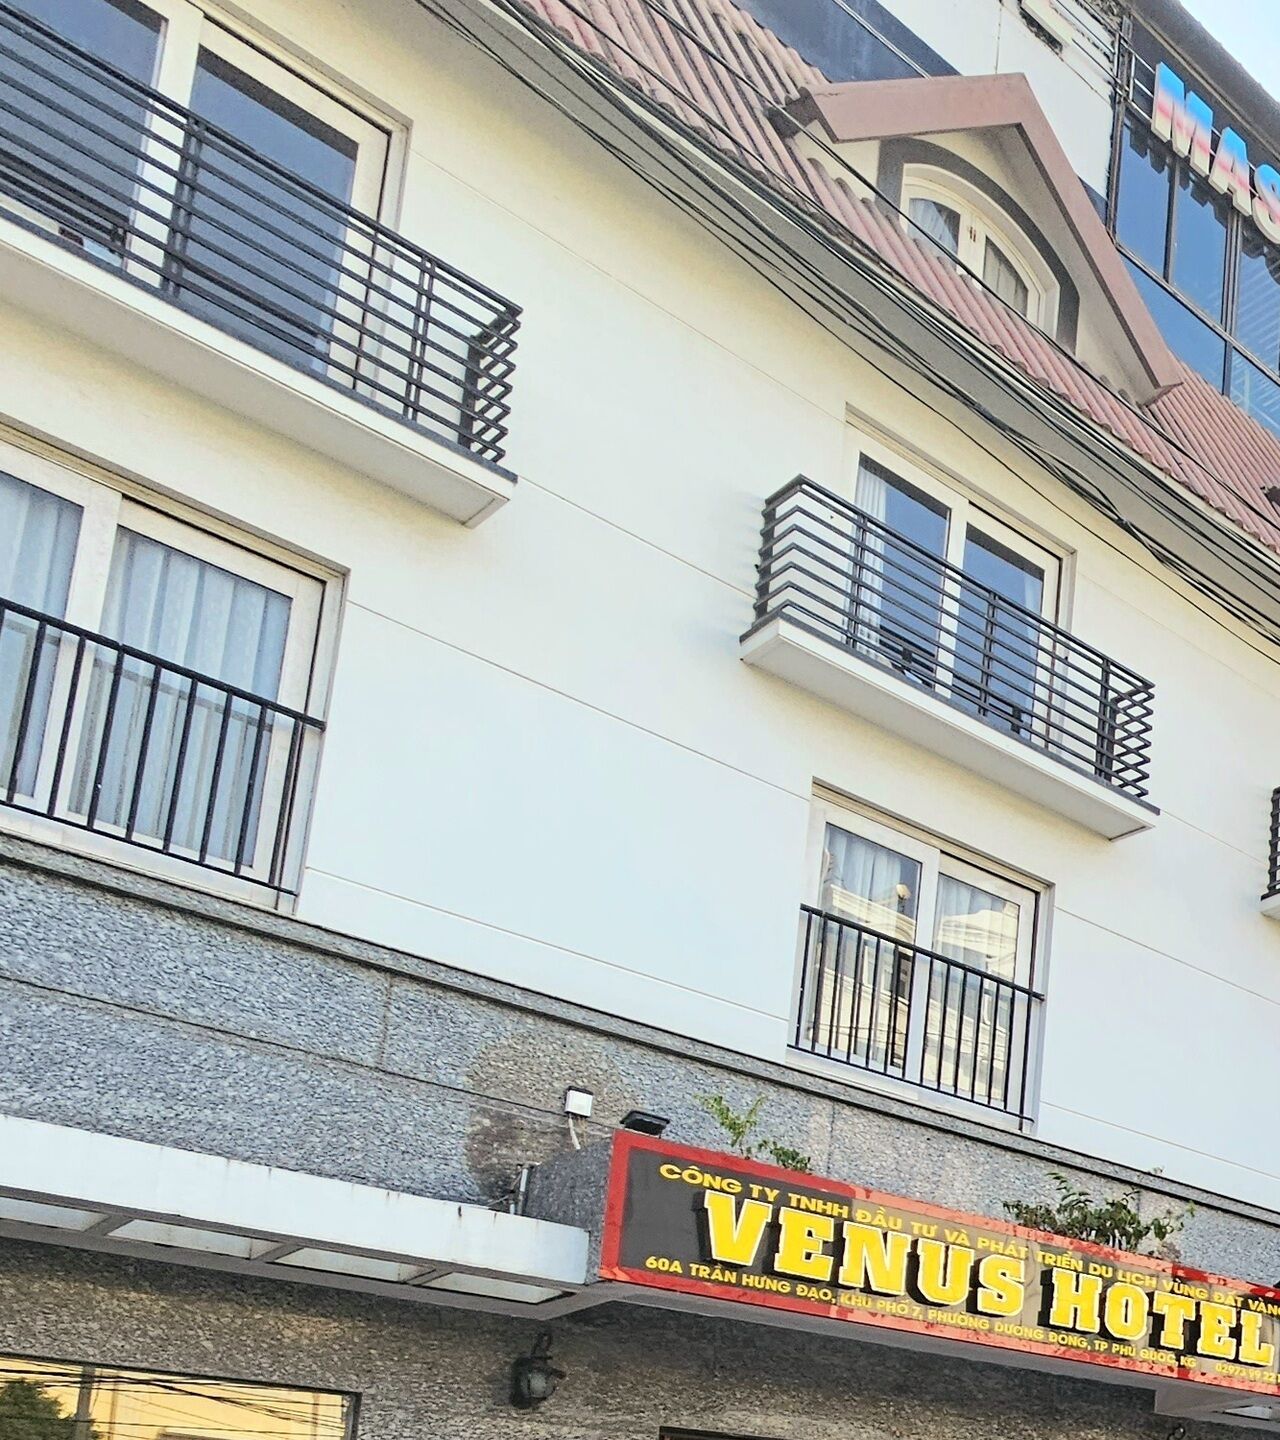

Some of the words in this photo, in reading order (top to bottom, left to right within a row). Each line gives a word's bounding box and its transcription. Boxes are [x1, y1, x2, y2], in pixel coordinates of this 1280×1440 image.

[659, 1163, 742, 1193] CÔNG
[749, 1184, 780, 1202] TY
[788, 1193, 849, 1218] TNHH
[855, 1207, 902, 1230] ĐẦU
[911, 1220, 937, 1238] TƯ
[944, 1229, 970, 1247] VÀ
[977, 1238, 1028, 1259] PHÁT
[1037, 1249, 1083, 1272] TRIỂN
[1089, 1263, 1113, 1278] DU
[1118, 1269, 1157, 1288] LỊCH
[1163, 1279, 1208, 1300] VÙNG
[1213, 1290, 1244, 1308] ĐẤT
[704, 1189, 1025, 1317] VENUS
[1049, 1267, 1274, 1366] HOTEL
[645, 1256, 683, 1275] 60A
[689, 1262, 737, 1284] TRẦN
[742, 1273, 792, 1293] HƯNG
[796, 1284, 837, 1305] ĐẠO,
[841, 1294, 872, 1309] KHU
[876, 1299, 909, 1315] PHỐ
[1094, 1339, 1108, 1351] TP
[1180, 1355, 1197, 1368] KG
